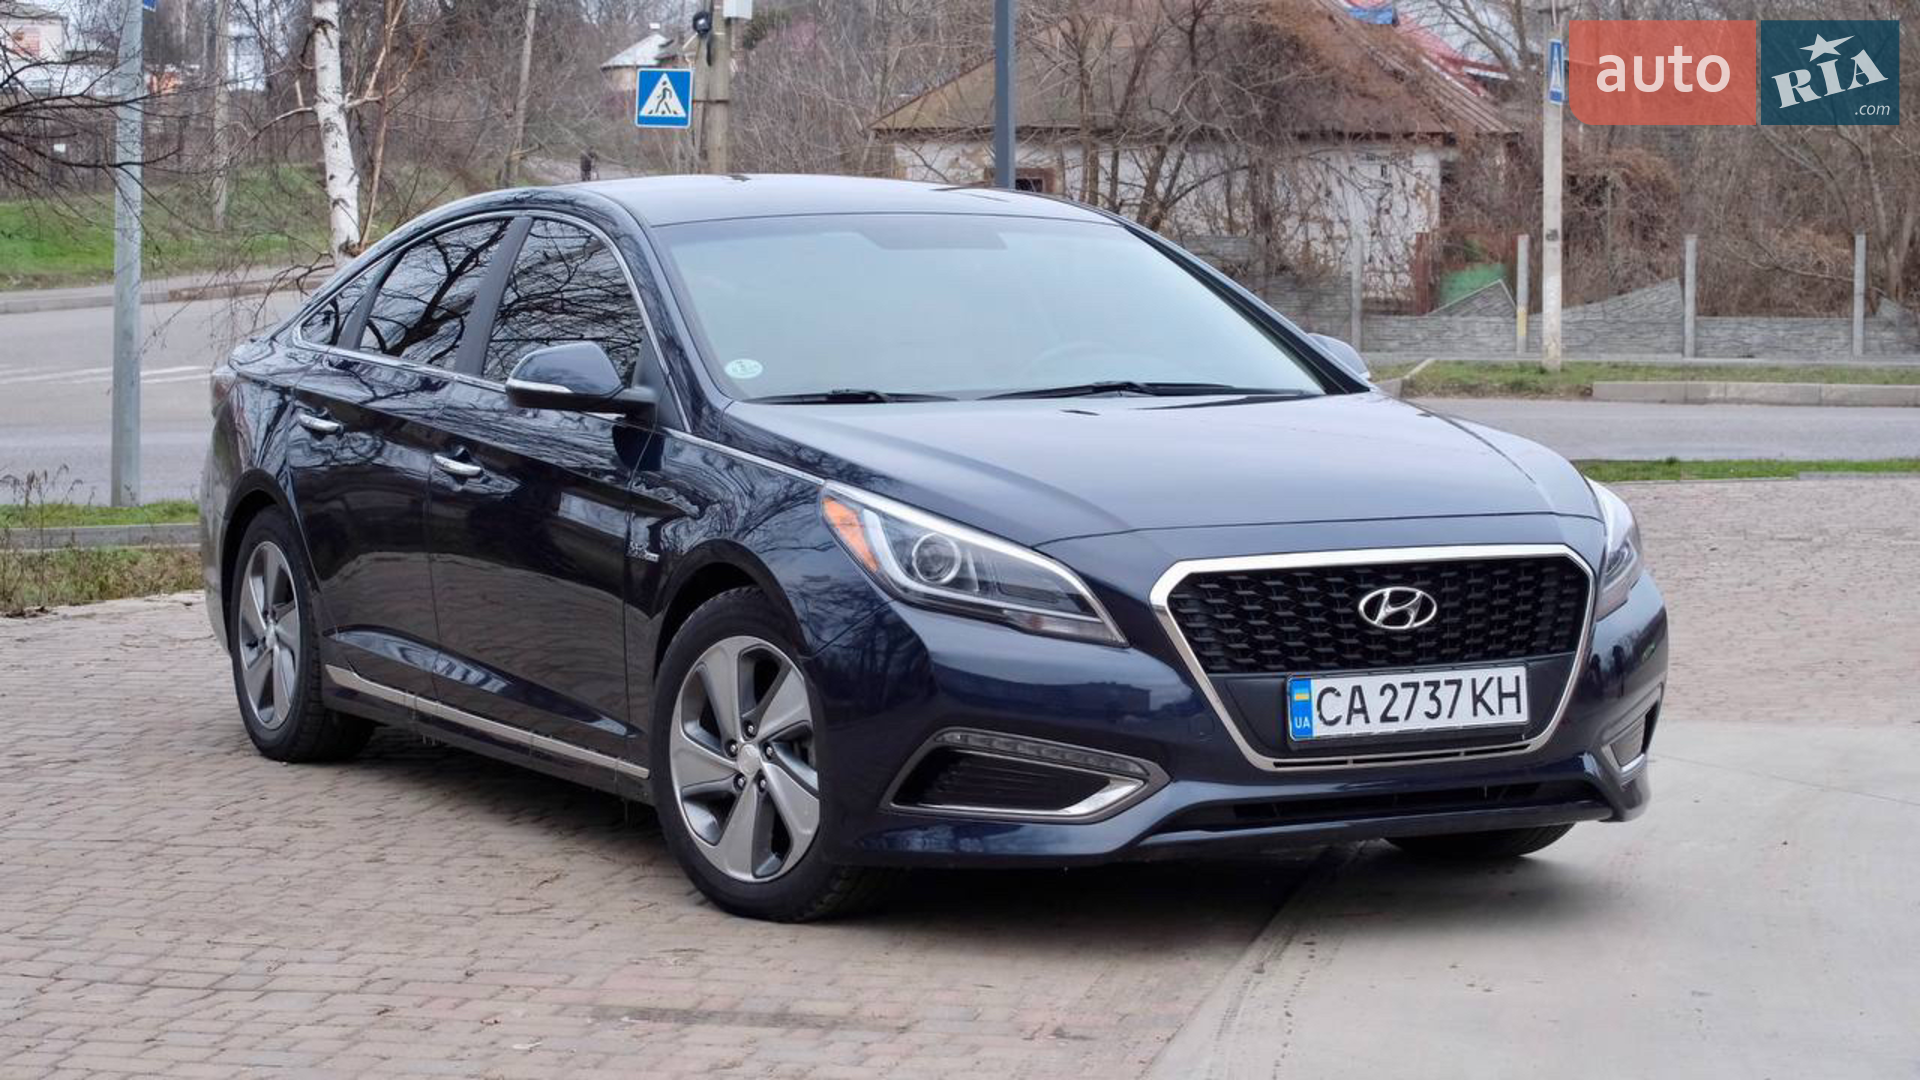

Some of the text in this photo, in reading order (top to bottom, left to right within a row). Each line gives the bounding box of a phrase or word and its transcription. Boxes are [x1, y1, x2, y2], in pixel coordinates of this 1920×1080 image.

[1316, 675, 1522, 726] CA 2737 KH
[1295, 717, 1310, 729] UA
